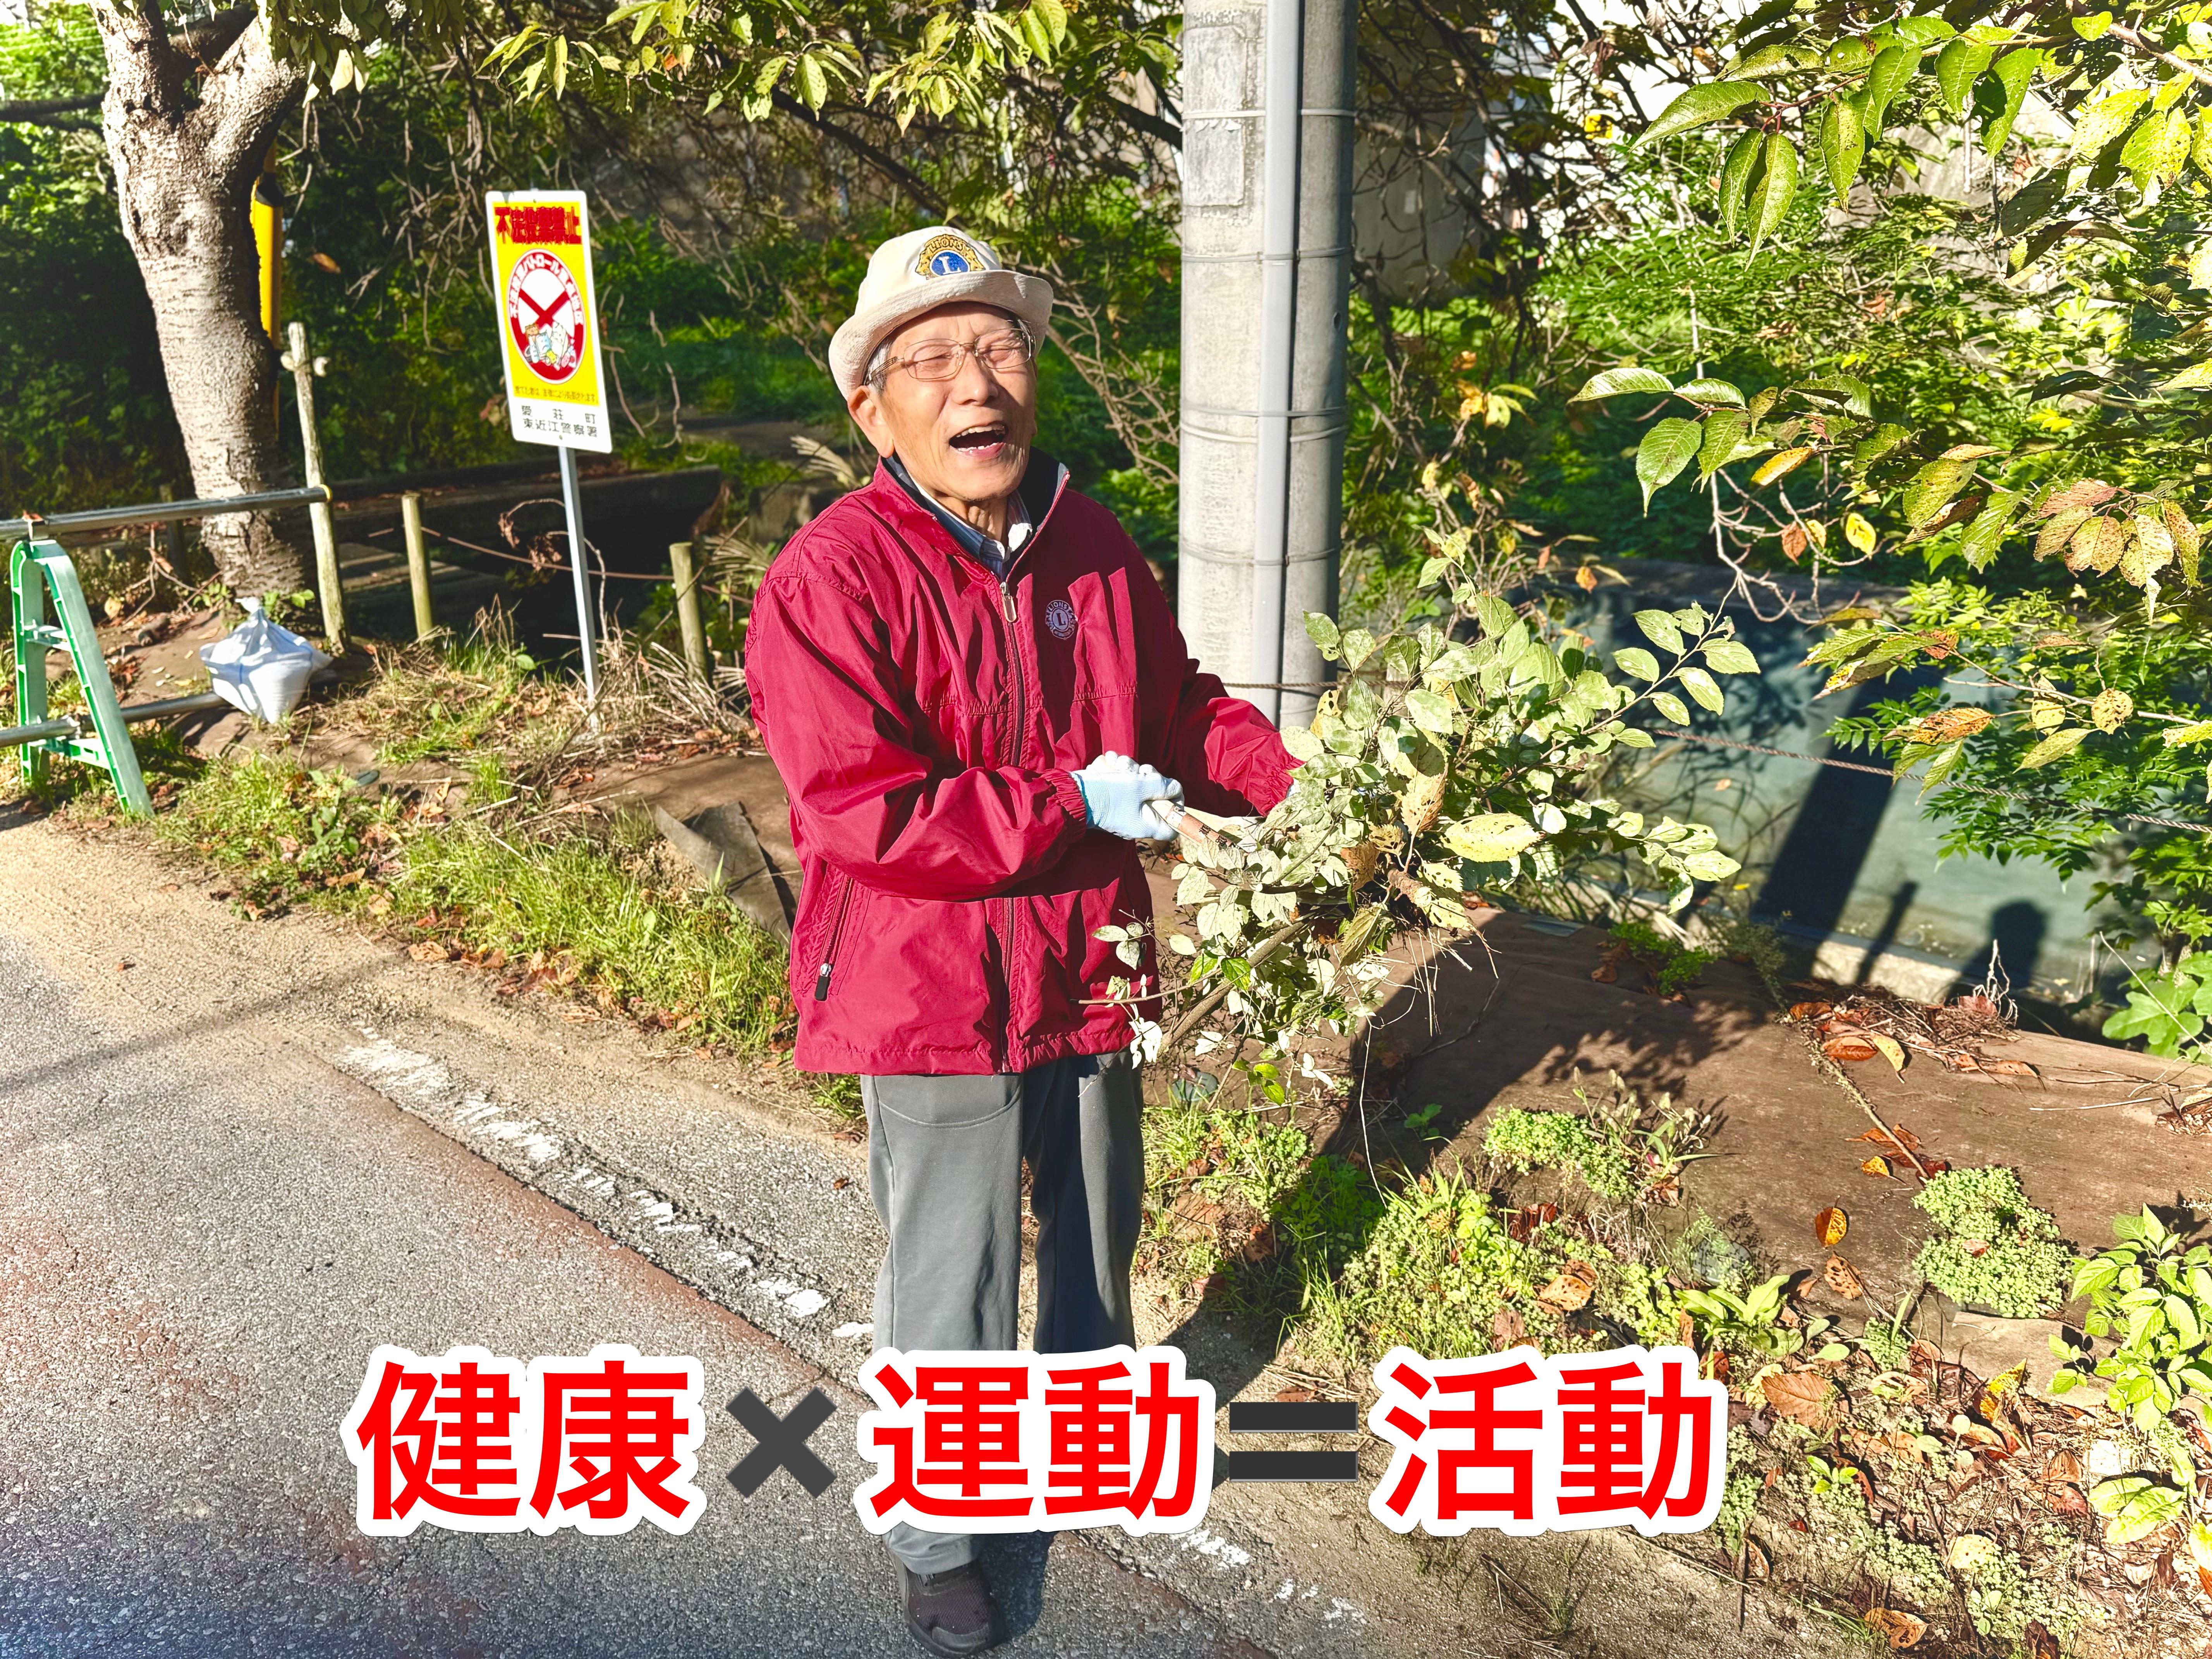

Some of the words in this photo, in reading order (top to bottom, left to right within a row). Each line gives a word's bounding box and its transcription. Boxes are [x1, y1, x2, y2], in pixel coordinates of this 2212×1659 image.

[495, 206, 582, 244] 不法投棄禁止
[929, 237, 964, 252] LIONS
[939, 256, 961, 274] L
[523, 418, 597, 437] 東近江警察署
[1048, 601, 1068, 611] LIONS
[1056, 613, 1066, 626] L
